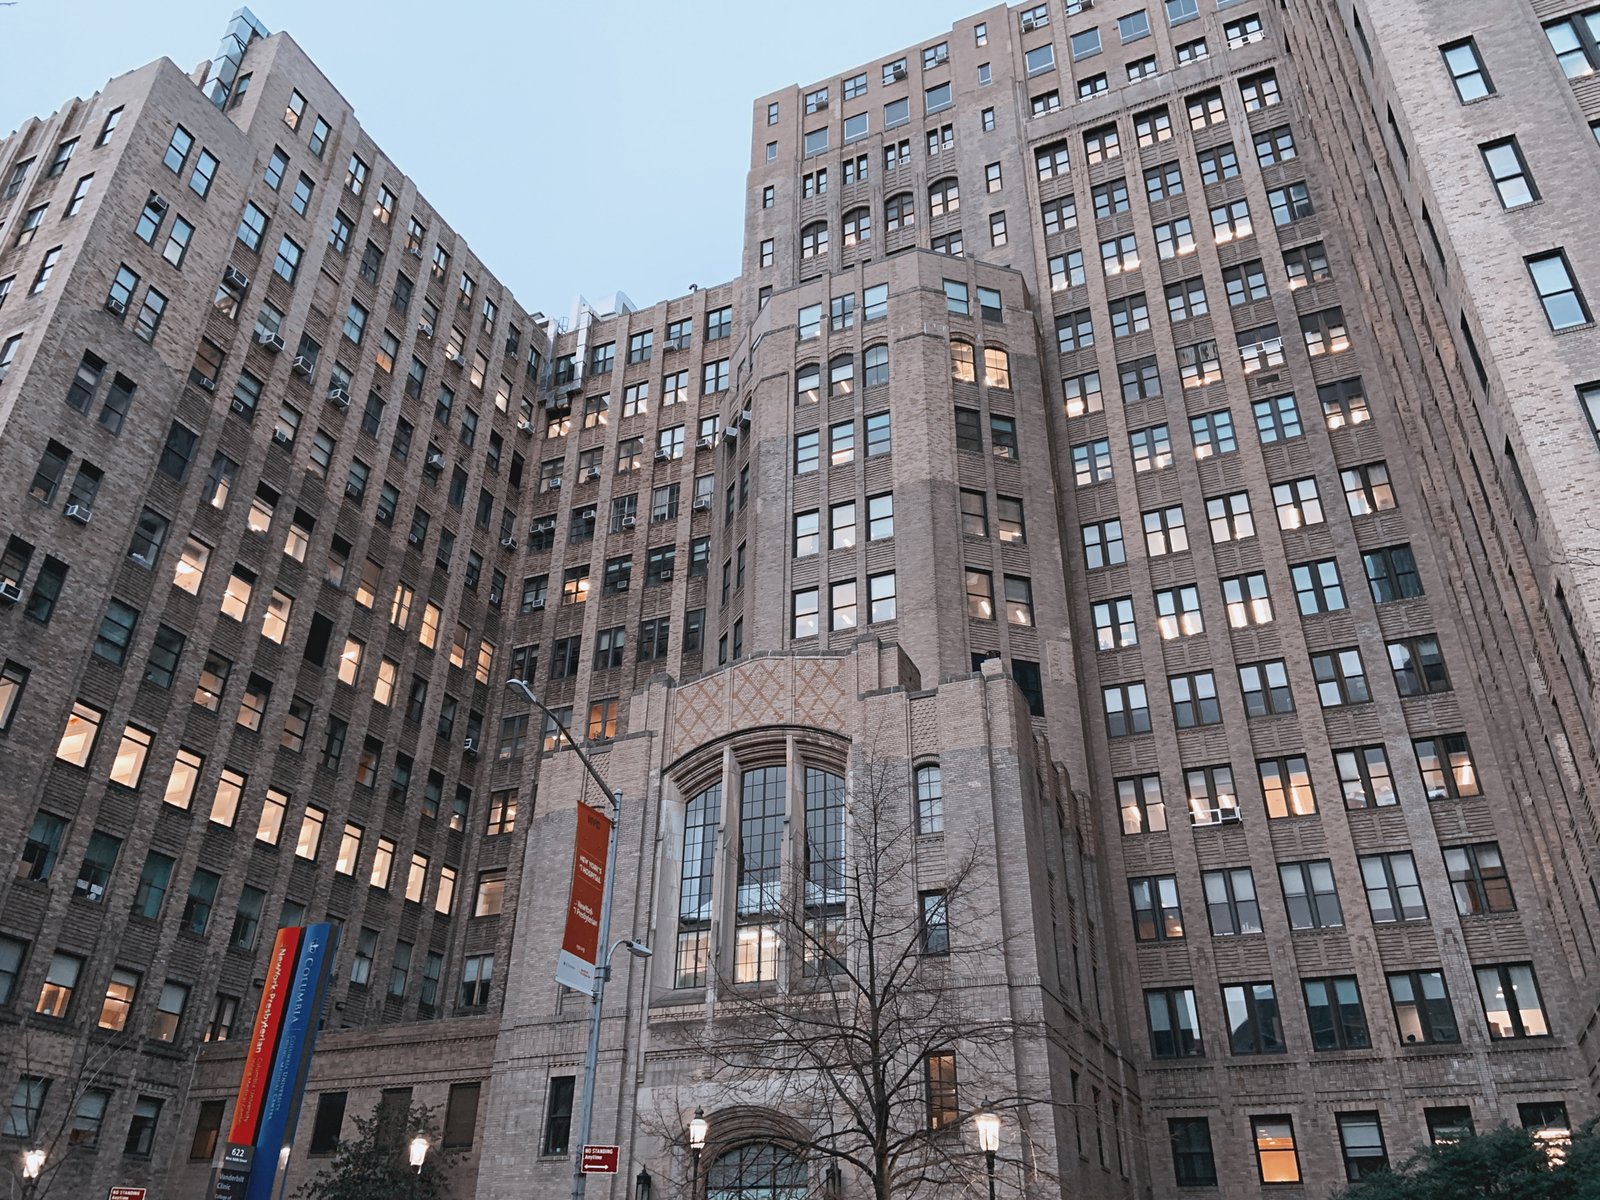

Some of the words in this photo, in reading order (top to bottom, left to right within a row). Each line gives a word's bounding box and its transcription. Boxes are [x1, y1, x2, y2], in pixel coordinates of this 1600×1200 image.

[290, 957, 314, 1024] COLUMBIA
[231, 1148, 245, 1157] 622
[219, 1174, 245, 1183] Vanderbilt
[216, 1183, 231, 1191] Clinic
